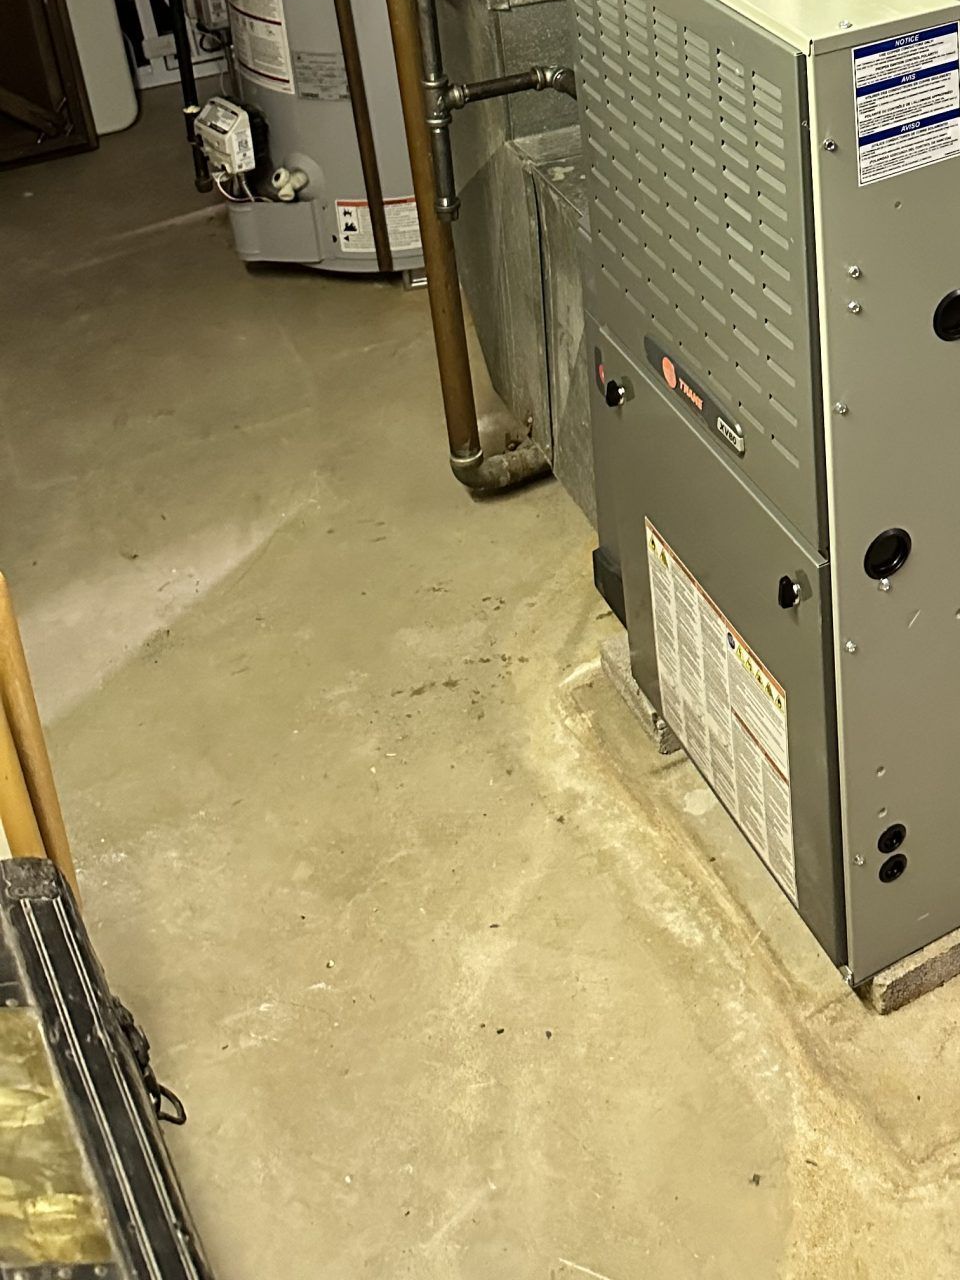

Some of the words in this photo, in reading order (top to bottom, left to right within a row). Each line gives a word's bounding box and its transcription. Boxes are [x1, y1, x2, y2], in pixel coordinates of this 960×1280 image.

[895, 34, 920, 47] NOTICE
[901, 74, 916, 84] AVIS
[900, 121, 921, 133] AVISO
[679, 377, 704, 411] TRANE
